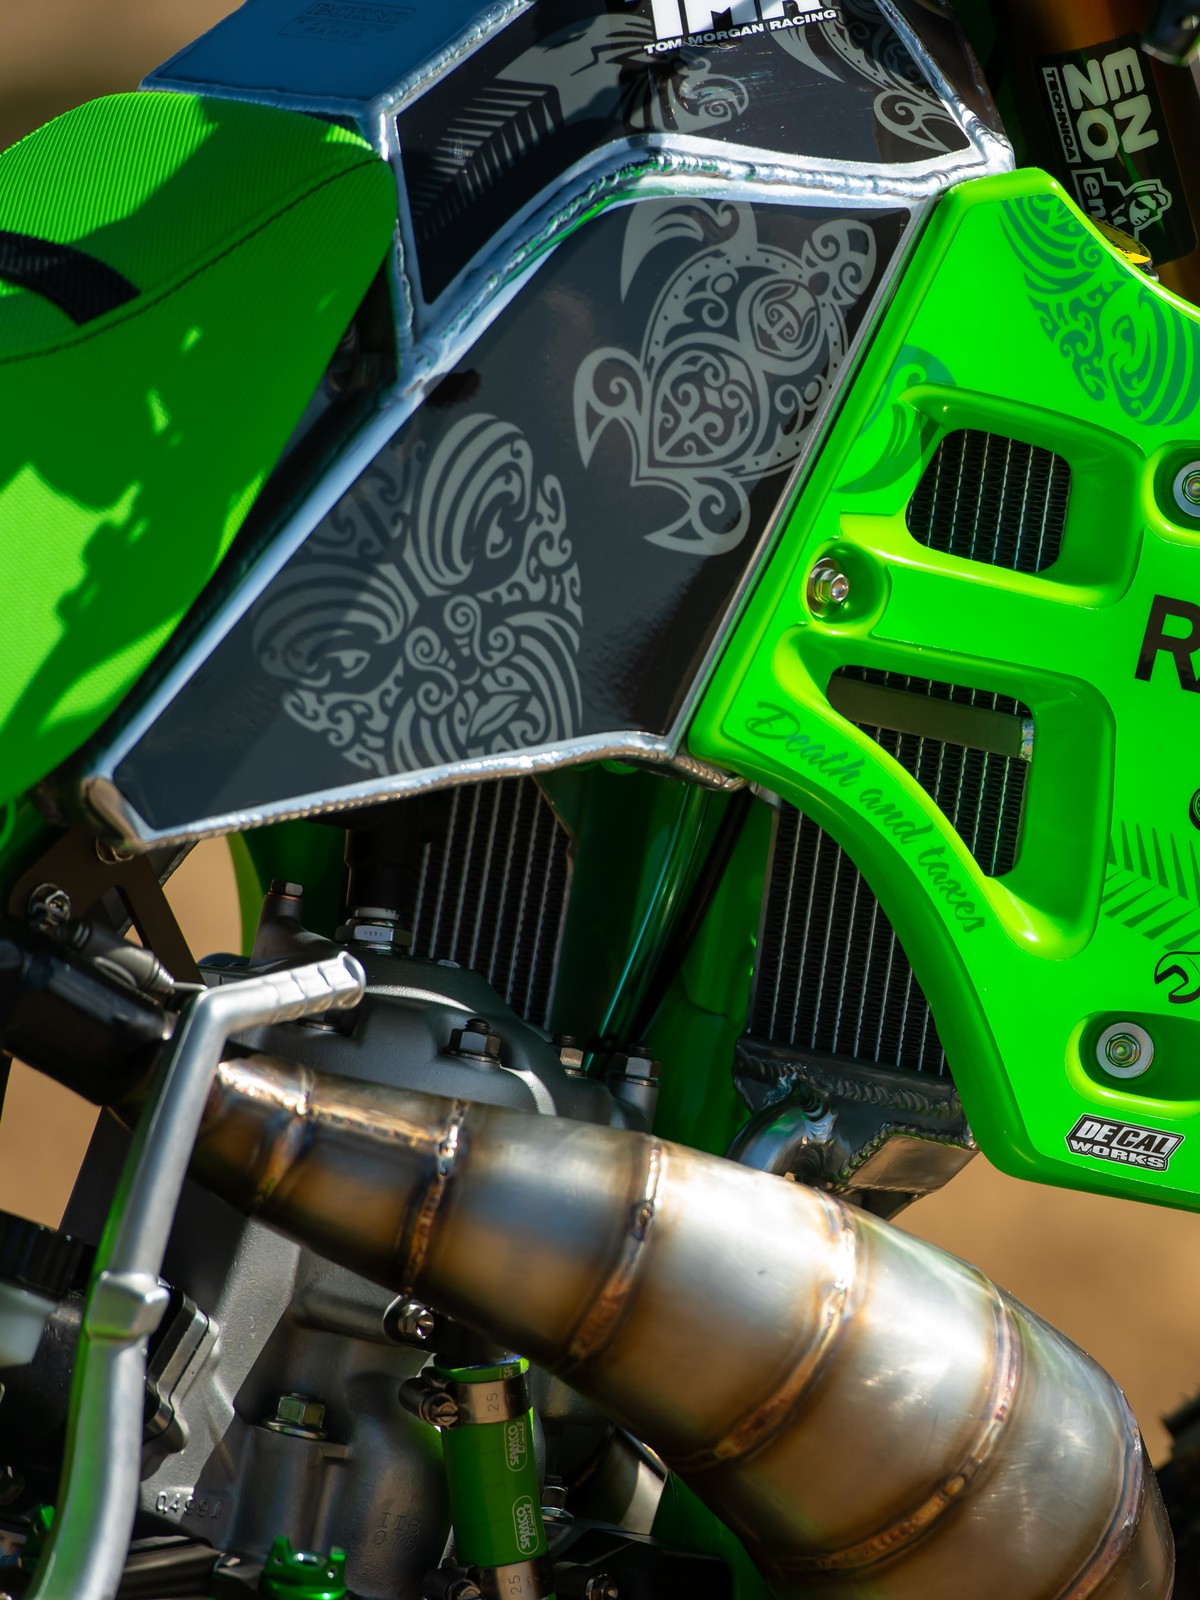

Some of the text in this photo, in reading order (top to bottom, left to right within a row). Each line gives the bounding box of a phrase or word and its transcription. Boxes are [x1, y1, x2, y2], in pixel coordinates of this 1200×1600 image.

[644, 9, 837, 54] TOM MORGAN RACING
[745, 701, 986, 934] Death and taxes
[1070, 1139, 1165, 1168] WORKS
[1075, 1120, 1182, 1158] DECAL
[487, 1392, 500, 1412] 25
[508, 1425, 519, 1466] SAMCO
[516, 1506, 531, 1549] SAMCO
[524, 1504, 536, 1535] sport
[508, 1574, 523, 1595] 25
